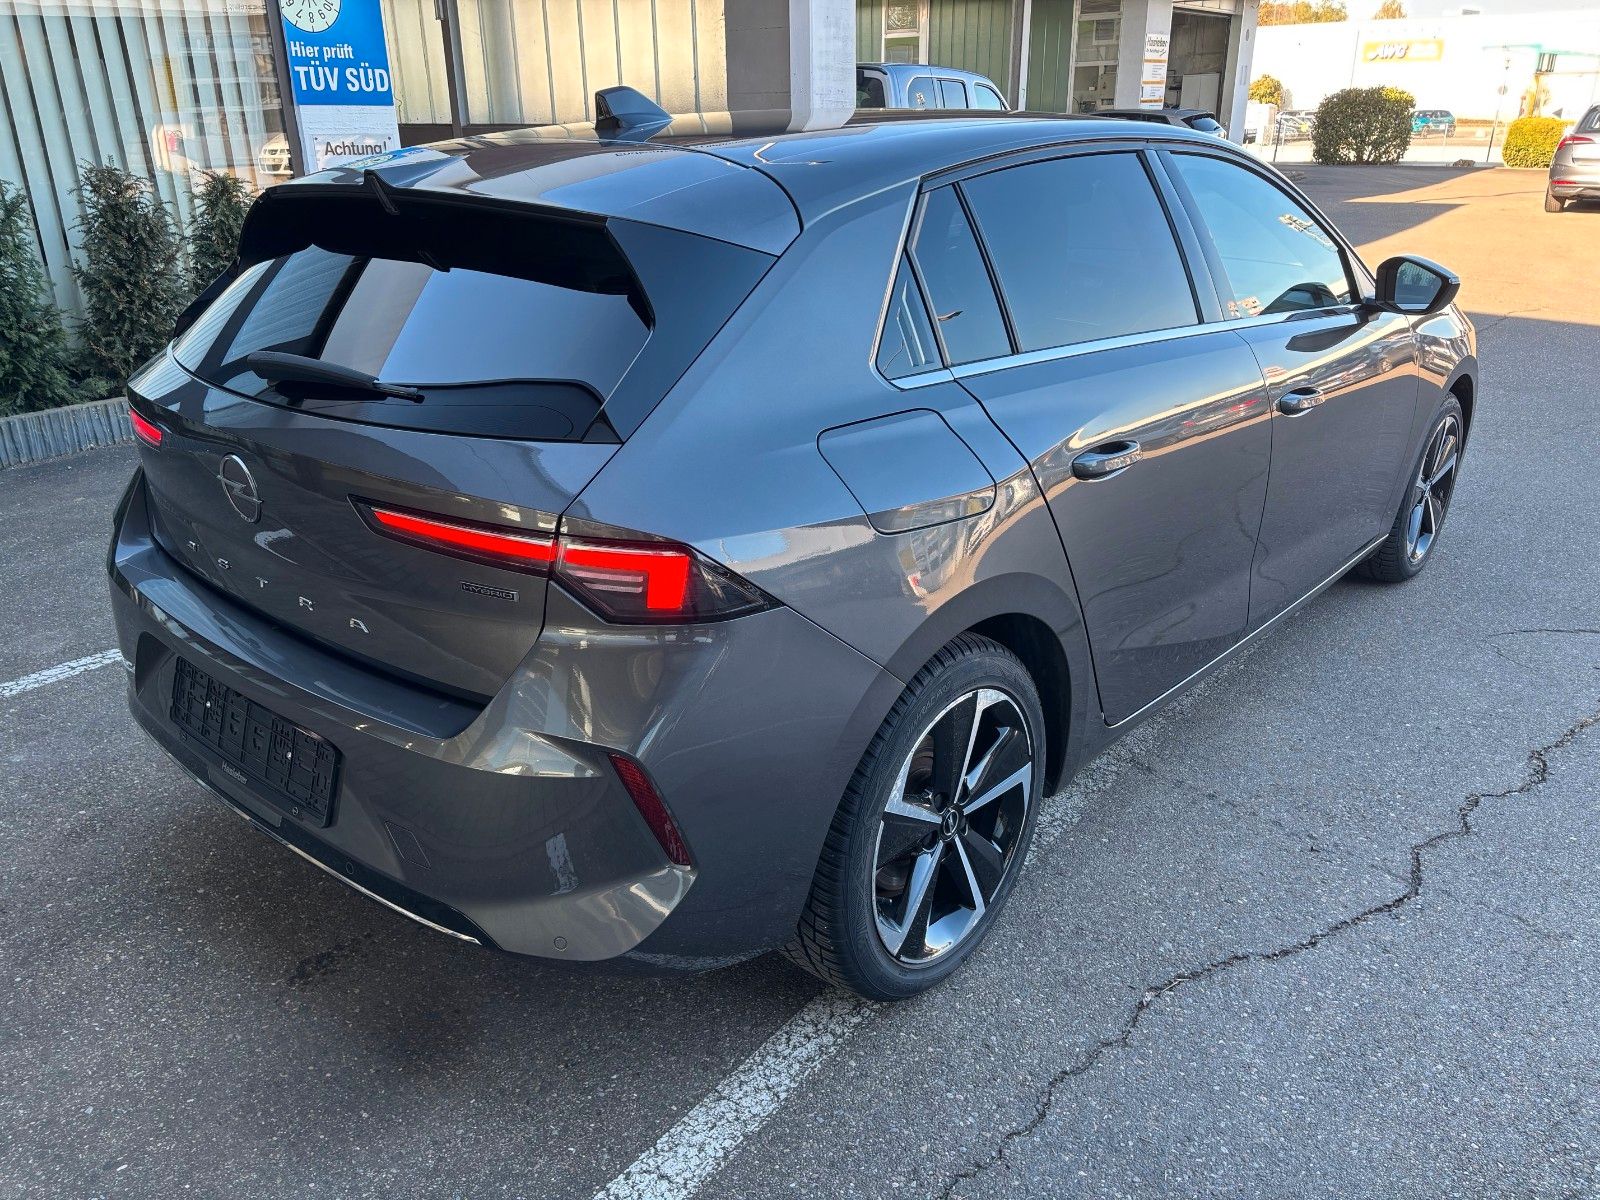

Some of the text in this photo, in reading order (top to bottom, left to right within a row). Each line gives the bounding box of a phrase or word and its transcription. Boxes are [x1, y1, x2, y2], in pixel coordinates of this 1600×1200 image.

[308, 11, 315, 23] 8
[317, 9, 326, 20] 9
[290, 41, 354, 62] Hier prüft
[294, 60, 389, 92] TÜV SÜD
[461, 583, 514, 600] HYBRID
